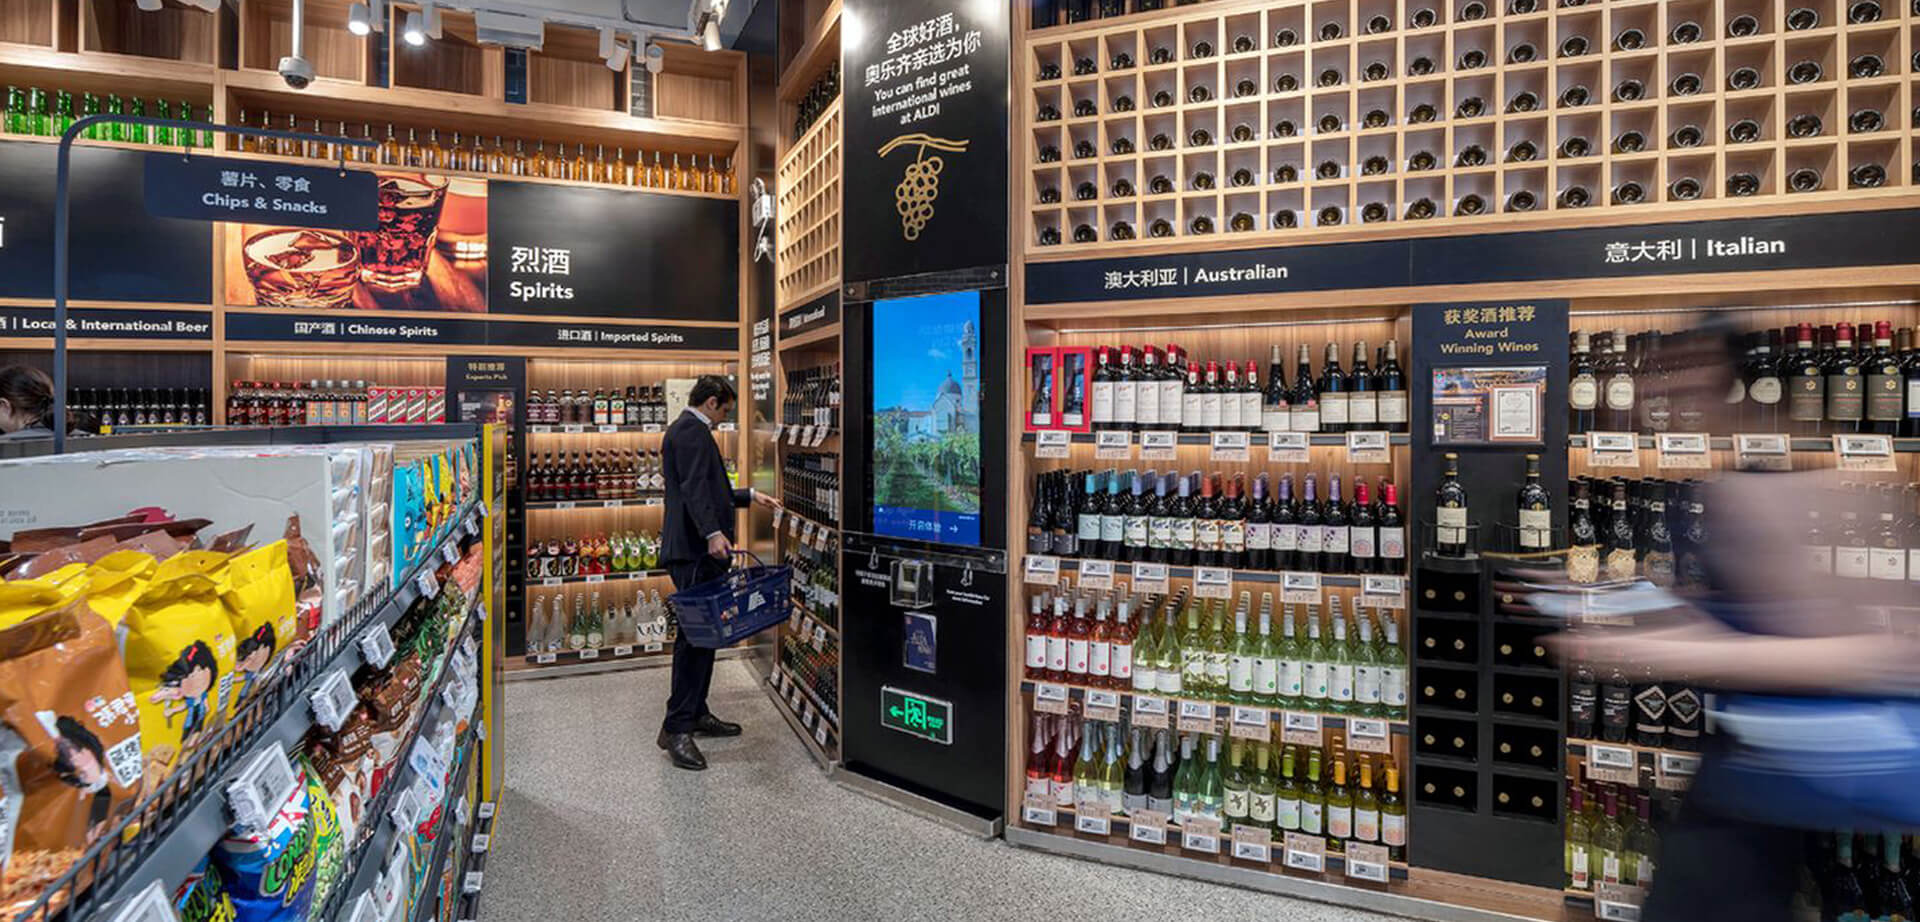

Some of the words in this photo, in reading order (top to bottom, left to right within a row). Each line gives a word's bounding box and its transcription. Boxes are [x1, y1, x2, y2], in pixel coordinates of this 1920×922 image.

[865, 30, 981, 87] 奥乐齐亲选为你
[874, 88, 894, 102] You
[895, 83, 914, 96] can
[915, 72, 937, 90] find
[939, 64, 970, 86] great
[872, 87, 937, 118] international
[939, 80, 972, 98] wines
[900, 113, 912, 125] at
[913, 103, 940, 122] ALDI
[220, 171, 312, 193] 薯片、零食
[202, 193, 249, 209] Chips
[254, 198, 267, 209] &
[273, 198, 328, 214] Snacks
[511, 246, 571, 275] 烈酒
[1604, 238, 1682, 264] 意大利
[1707, 236, 1786, 257] Italian
[1104, 267, 1178, 290] 澳大利亚
[1194, 264, 1289, 283] Australian
[509, 281, 575, 302] Spirits
[22, 317, 56, 330] Loca
[81, 319, 173, 332] International
[176, 321, 209, 333] Beer
[1443, 305, 1536, 325] 获奖酒推荐
[348, 323, 397, 336] Chinese
[399, 325, 439, 338] Spirits
[557, 329, 593, 342] 进口酒
[600, 331, 649, 344] Imported
[651, 332, 684, 344] Spirits
[1464, 327, 1509, 340] Award
[1440, 343, 1494, 355] Winning
[1497, 342, 1539, 352] Wines
